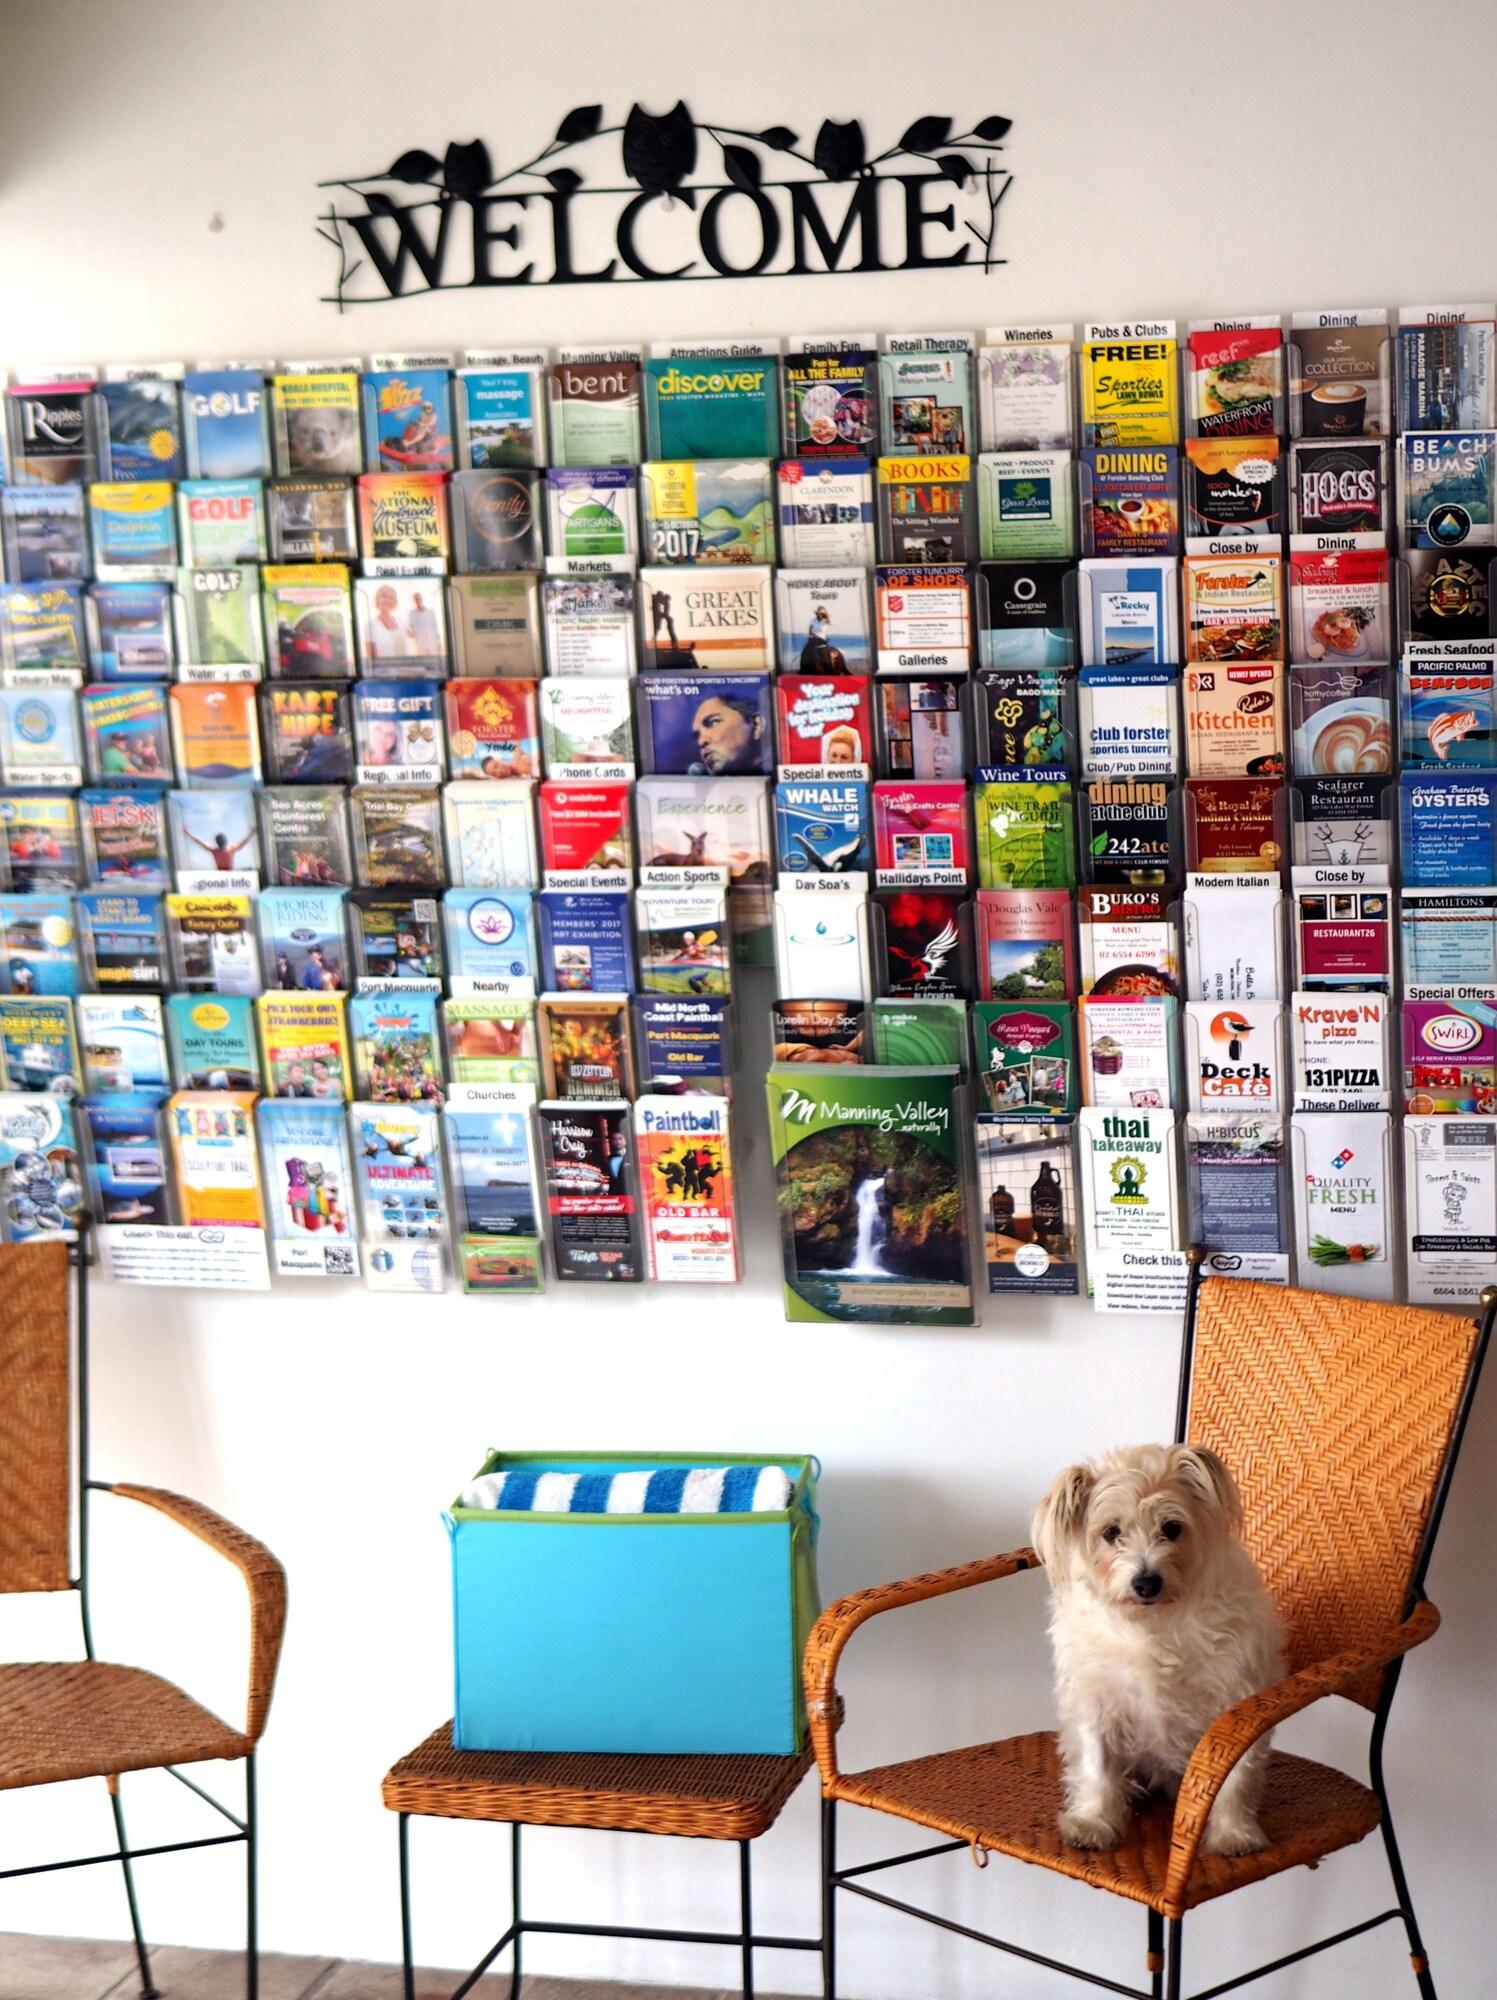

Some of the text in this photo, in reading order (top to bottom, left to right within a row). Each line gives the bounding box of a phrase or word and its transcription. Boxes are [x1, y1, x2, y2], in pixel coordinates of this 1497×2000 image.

[347, 174, 970, 300] WELCOME
[1319, 314, 1357, 328] Dining
[1425, 312, 1466, 325] Dining
[1005, 329, 1053, 342] Wineries
[1091, 324, 1168, 340] Pubs & Clubs
[671, 346, 763, 360] Attractions Guide
[804, 343, 861, 356] Family Fun
[891, 338, 969, 355] Retail Therapy
[1091, 344, 1168, 363] FREE!
[813, 360, 840, 371] Fun for
[1305, 362, 1376, 377] COLLECTION
[656, 369, 765, 396] discover
[789, 368, 865, 384] ALL THE FAMILY
[1417, 333, 1425, 419] PARADISE MARINA
[191, 391, 261, 418] GOLF
[477, 389, 524, 405] massage
[22, 400, 84, 446] Ripples
[1201, 401, 1273, 431] WATERFRONT
[1205, 418, 1273, 438] DINING
[1096, 451, 1168, 474] DINING
[1413, 457, 1477, 477] BUMS
[891, 461, 962, 482] BOOKS
[1302, 469, 1376, 518] HOGS
[190, 498, 254, 521] GOLF
[371, 496, 437, 508] NATIONAL
[373, 520, 439, 537] MUSEUM
[653, 529, 699, 558] 2017
[1209, 541, 1259, 557] Close by
[1317, 539, 1356, 553] Dining
[568, 561, 612, 575] Markets
[888, 567, 965, 578] FORSTER TUNCURRY
[194, 571, 241, 592] GOLF
[787, 578, 858, 592] HORSE ABOUT
[888, 574, 965, 587] OP SHOPS
[685, 591, 759, 611] GREAT
[809, 591, 838, 603] Tours
[1231, 588, 1274, 599] Restaurant
[1004, 601, 1048, 611] Cassegrain
[688, 609, 760, 631] LAKES
[1409, 642, 1495, 656] Fresh Seafood
[898, 654, 948, 670] Galleries
[1418, 660, 1489, 672] PACIFIC PALMS
[645, 685, 700, 695] what's on
[1410, 676, 1494, 690] SEAFOOD
[361, 697, 434, 713] FREE GIFT
[1190, 711, 1274, 731] Kitchen
[1090, 726, 1171, 741] club forster
[1090, 745, 1129, 757] sporties
[980, 767, 1067, 782] Wine Tours
[1087, 761, 1172, 776] Club/Pub Dining
[783, 769, 864, 784] Special events
[1088, 776, 1168, 803] dining
[1316, 781, 1365, 792] Seafarer
[786, 788, 858, 805] WHALE
[1311, 794, 1375, 805] Restaurant
[1411, 793, 1490, 808] OYSTERS
[822, 803, 859, 813] WATCH
[989, 801, 1060, 812] WINE TRAIL
[1091, 804, 1168, 821] at the club
[1219, 801, 1249, 812] Royal
[1019, 811, 1061, 822] GUIDE
[1108, 837, 1170, 855] 242ate
[548, 875, 627, 892] Special Events
[647, 869, 721, 885] Action Sports
[879, 871, 963, 888] Hallidays Point
[1195, 876, 1270, 888] Modern Italian
[1315, 869, 1366, 885] Close by
[989, 902, 1033, 917] Douglas
[1090, 892, 1160, 915] BUKO'S
[1418, 897, 1485, 908] HAMILTONS
[602, 919, 622, 928] 2017
[572, 930, 623, 939] EXHIBITION
[473, 981, 510, 996] Nearby
[1410, 987, 1496, 1002] Special Offers
[654, 1002, 710, 1013] Mid North
[1299, 1005, 1380, 1024] Krave'N
[267, 1016, 339, 1027] STRAWBERRIES
[1322, 1025, 1357, 1040] pizza
[1430, 1022, 1471, 1041] SWIRL
[211, 1038, 246, 1049] TOURS
[1200, 1063, 1271, 1079] Deck
[1304, 1068, 1380, 1088] 131PIZZA
[466, 1090, 516, 1101] Churches
[1300, 1099, 1380, 1112] These Deliver
[819, 1100, 950, 1133] Manning Valley
[1102, 1115, 1151, 1139] thai
[1092, 1137, 1163, 1154] takeaway
[367, 1165, 433, 1180] ULTIMATE
[1313, 1177, 1371, 1189] QUALITY
[1308, 1188, 1378, 1205] FRESH
[656, 1207, 719, 1218] OLD BAR
[1115, 1207, 1144, 1217] THAI
[1330, 1206, 1357, 1214] MENU
[1123, 1254, 1182, 1267] Check this
